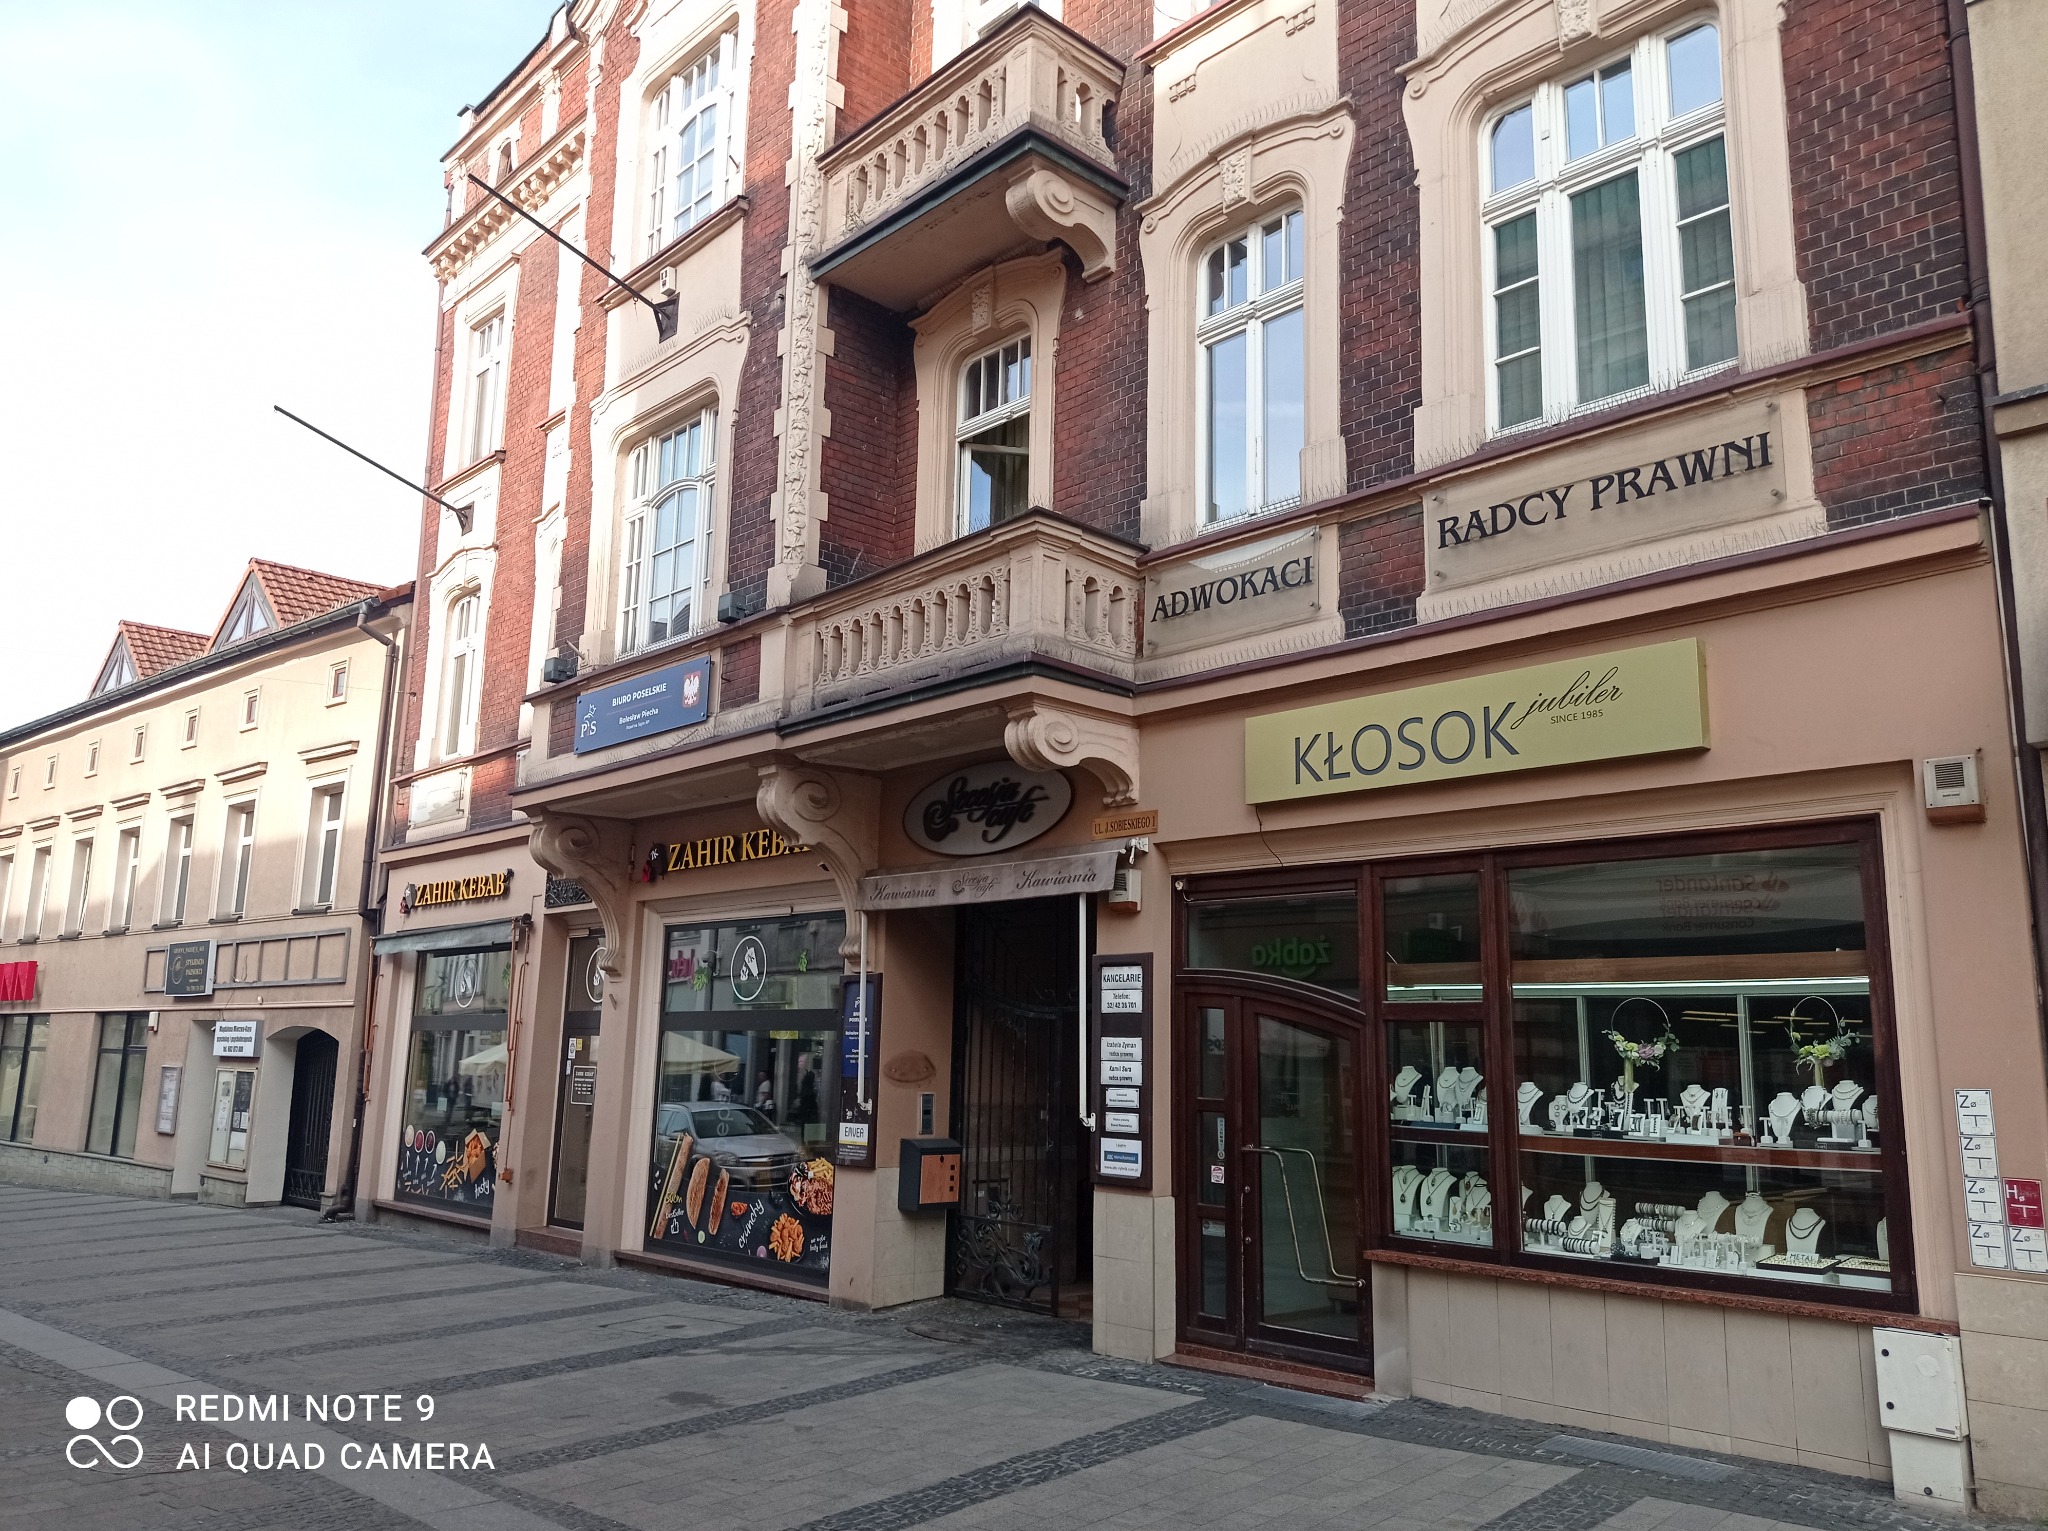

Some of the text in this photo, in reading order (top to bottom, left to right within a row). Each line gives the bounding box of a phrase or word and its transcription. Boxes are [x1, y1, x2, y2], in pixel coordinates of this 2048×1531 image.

[1437, 431, 1773, 549] RADCY PRAWNI
[1151, 556, 1312, 622] ADWOKACI
[612, 682, 667, 707] BIURO POSELSKIE
[641, 707, 659, 718] Piecha
[1294, 666, 1623, 785] KŁOSOK jubiler
[1550, 709, 1604, 725] SINCE 1985
[667, 828, 811, 872] ZAHIR KEB
[414, 872, 505, 906] ZAHIR KEBAB
[870, 885, 935, 901] Kawiarnia
[1016, 868, 1097, 890] Kawiarnia
[1103, 973, 1142, 983] KANCELARIE
[738, 1199, 765, 1249] crunchy
